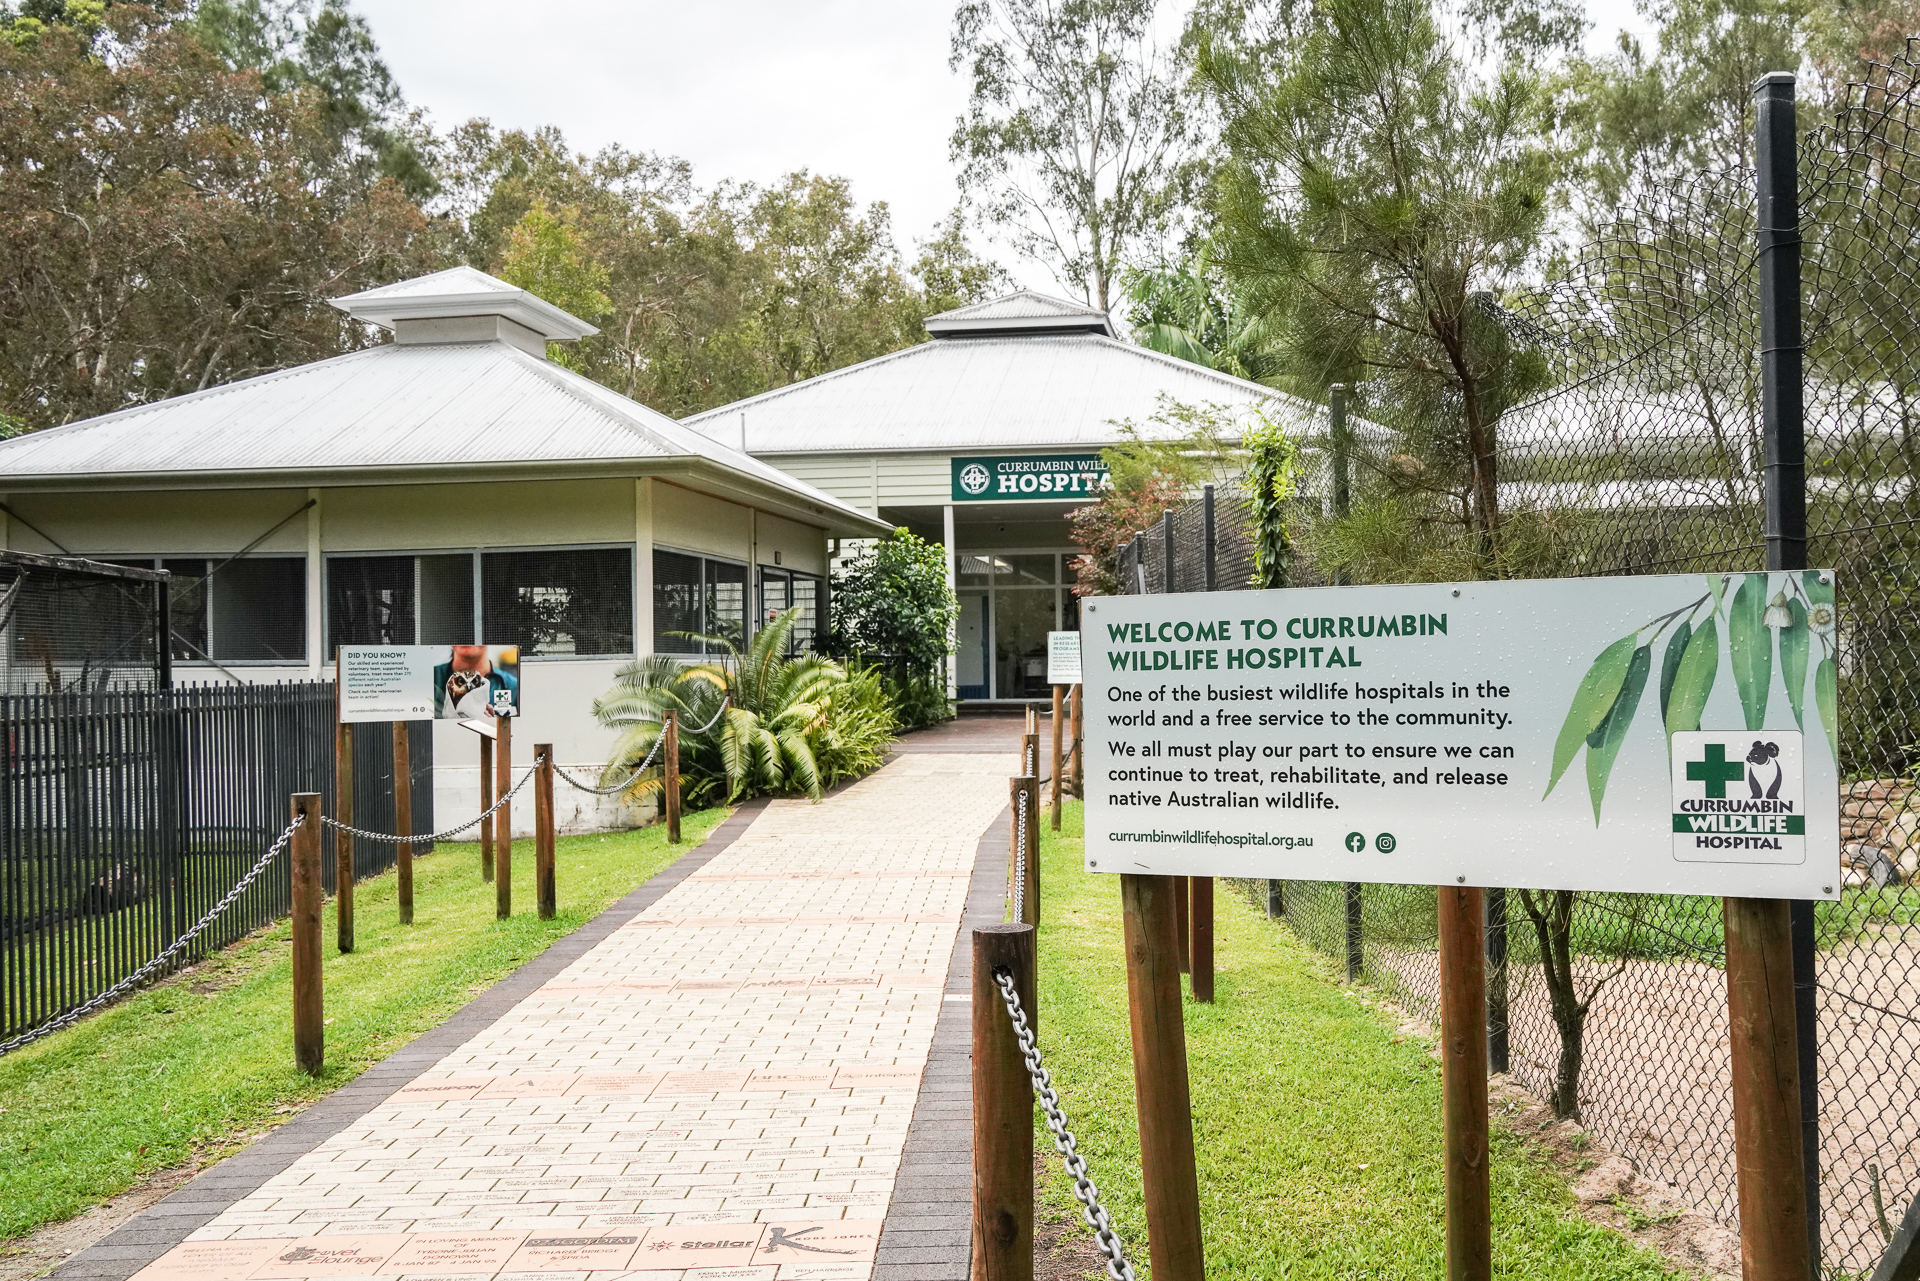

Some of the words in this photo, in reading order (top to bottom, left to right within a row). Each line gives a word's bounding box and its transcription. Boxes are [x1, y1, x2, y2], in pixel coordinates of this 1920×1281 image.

[997, 461, 1074, 474] CURRUMBIN
[1077, 460, 1111, 471] WILD
[997, 472, 1115, 495] HOSPITA
[1106, 620, 1232, 644] WELCOME
[1239, 618, 1278, 641] TO
[1286, 613, 1448, 640] CURRUMBIN
[1107, 649, 1219, 672] WILDLIFE
[1226, 645, 1363, 670] HOSPITAL
[1107, 686, 1143, 703] One
[1147, 684, 1167, 702] of
[1171, 684, 1201, 702] the
[1207, 683, 1274, 702] busiest
[1278, 681, 1349, 701] wildlife
[1355, 680, 1445, 705] hospitals
[1451, 681, 1469, 699] in
[1475, 679, 1511, 699] the
[1107, 709, 1156, 727] world
[1161, 709, 1194, 727] and
[1199, 714, 1210, 727] a
[1215, 708, 1253, 726] free
[1258, 709, 1324, 726] service
[1329, 710, 1351, 726] to
[1356, 707, 1390, 726] the
[1395, 707, 1513, 730] community.
[1107, 741, 1136, 757] We
[1141, 740, 1161, 757] all
[1167, 743, 1212, 758] must
[1218, 740, 1257, 763] play
[1262, 745, 1293, 758] our
[1299, 743, 1339, 763] part
[1344, 743, 1366, 758] to
[1371, 745, 1438, 759] ensure
[1443, 746, 1473, 759] we
[1478, 745, 1514, 759] can
[1108, 765, 1184, 782] continue
[1188, 767, 1209, 783] to
[1213, 768, 1264, 786] treat,
[1270, 765, 1386, 788] rehabilitate,
[1392, 766, 1428, 785] and
[1435, 766, 1509, 786] release
[1109, 790, 1162, 807] native
[1167, 790, 1259, 808] Australian
[1265, 791, 1339, 810] wildlife.
[1680, 799, 1794, 814] CURRUMBIN
[1687, 814, 1788, 833] WILDLIFE
[1108, 829, 1314, 851] currumbinwildlifehospital.org.au
[1695, 836, 1783, 851] HOSPITAL
[401, 1085, 482, 1093] GROUPON
[680, 1240, 755, 1249] Stellar
